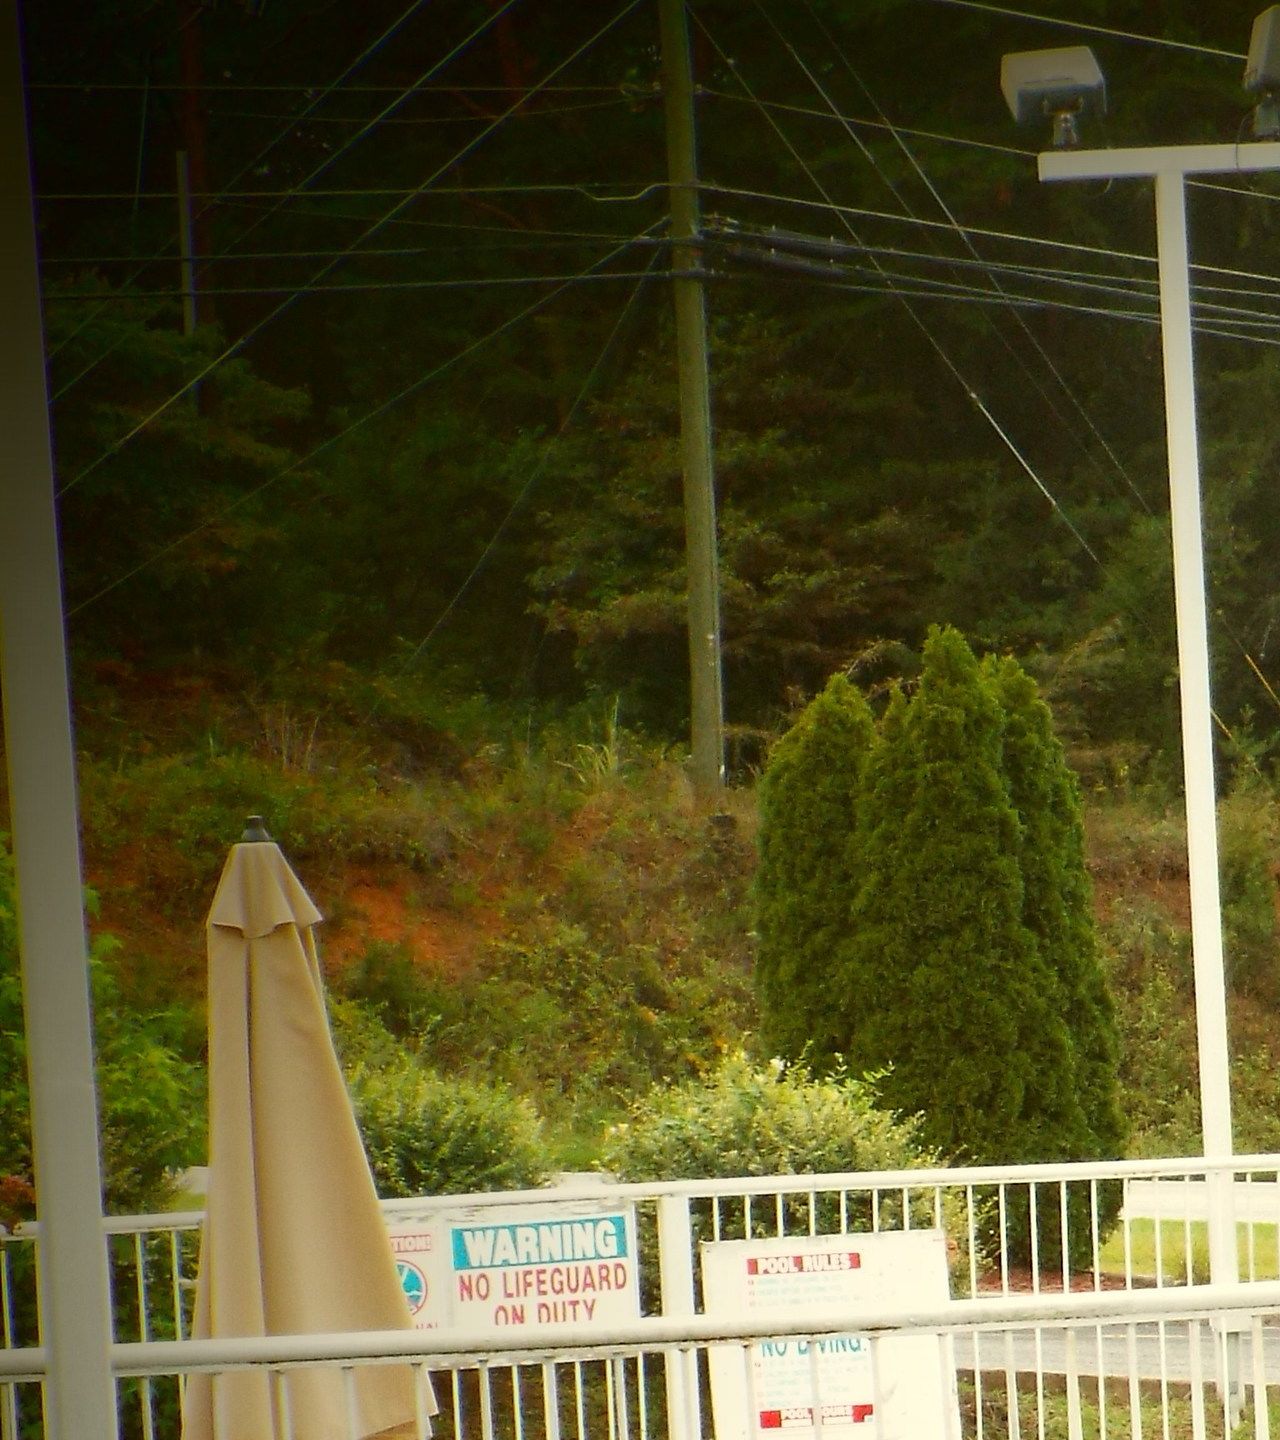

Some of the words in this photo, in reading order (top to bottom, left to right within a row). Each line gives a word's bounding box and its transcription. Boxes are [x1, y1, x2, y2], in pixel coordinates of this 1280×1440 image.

[462, 1220, 618, 1268] WARNING
[758, 1257, 799, 1274] POOL
[802, 1252, 850, 1272] RULES
[459, 1273, 490, 1302] NO
[502, 1262, 628, 1299] LIFEGUARD
[494, 1303, 525, 1326] ON
[538, 1298, 597, 1323] DUTY
